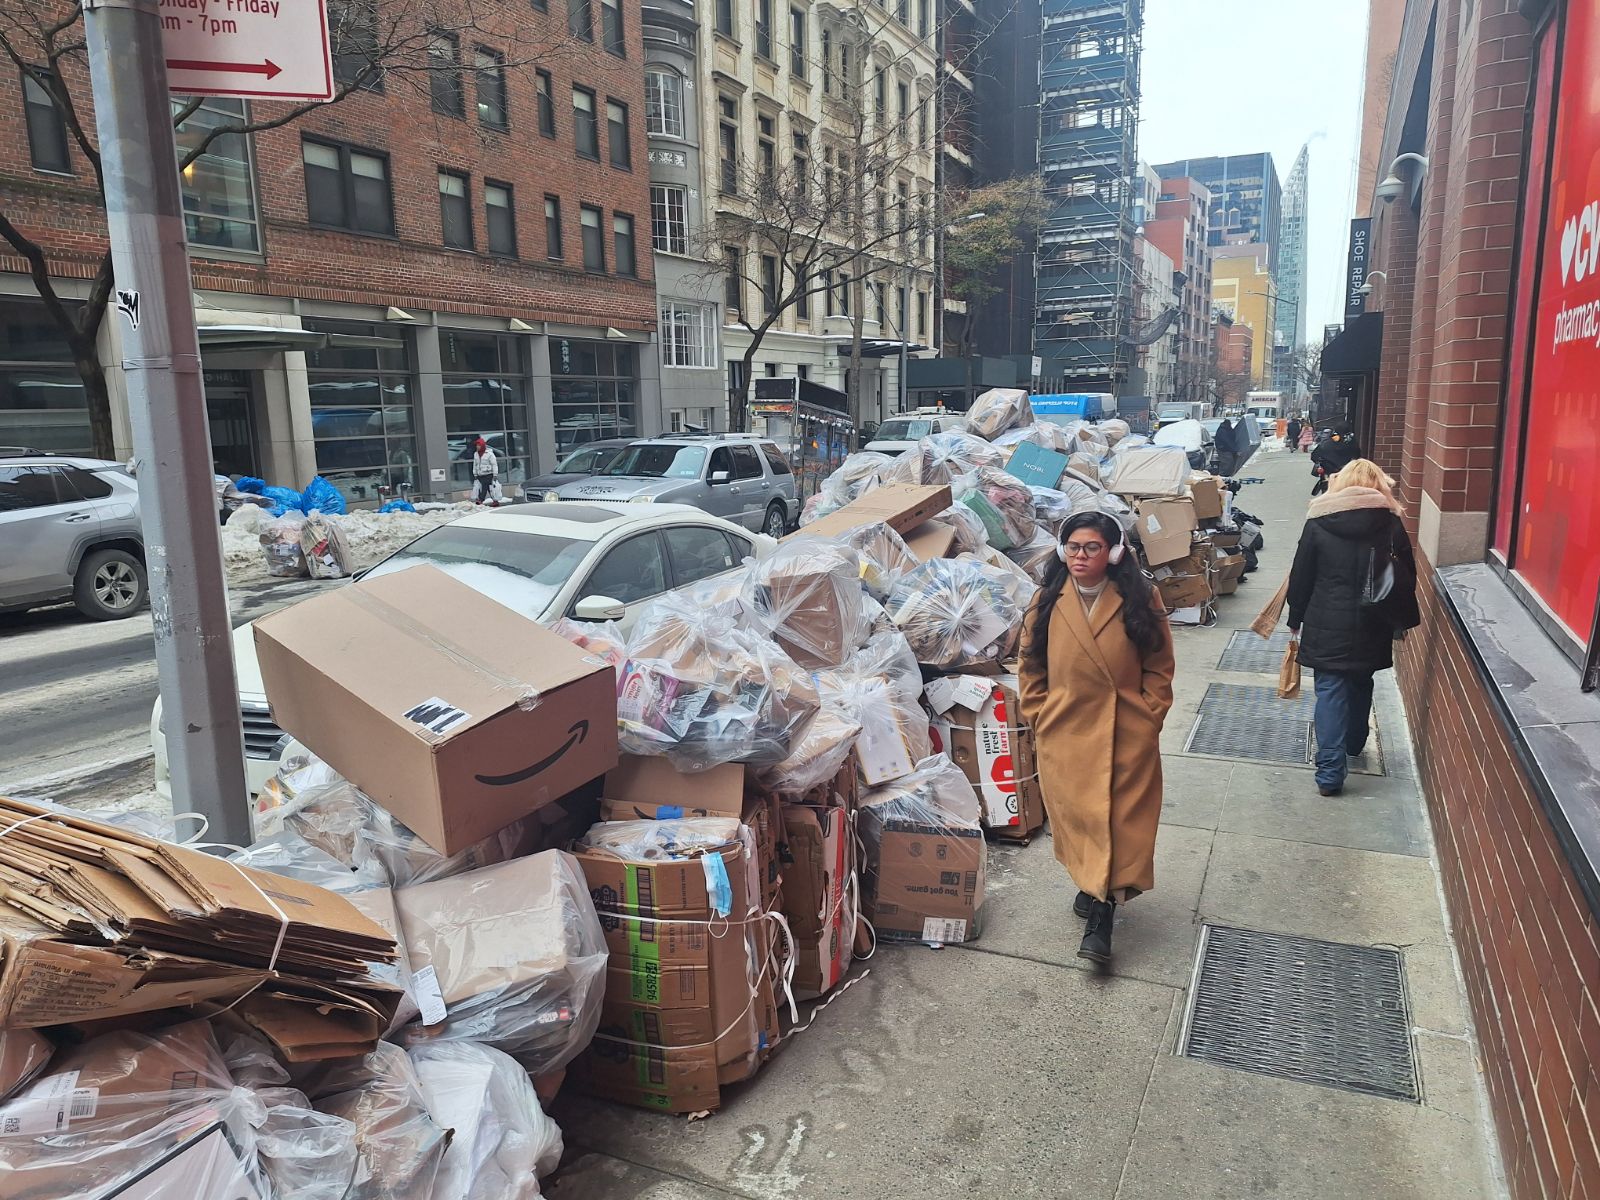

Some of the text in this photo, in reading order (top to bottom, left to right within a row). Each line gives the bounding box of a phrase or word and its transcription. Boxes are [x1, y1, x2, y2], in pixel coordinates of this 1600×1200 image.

[227, 0, 279, 18] Friday
[198, 15, 237, 36] 7pm
[1350, 230, 1366, 306] SHOE REPAIR
[929, 886, 944, 895] got
[944, 889, 959, 897] You
